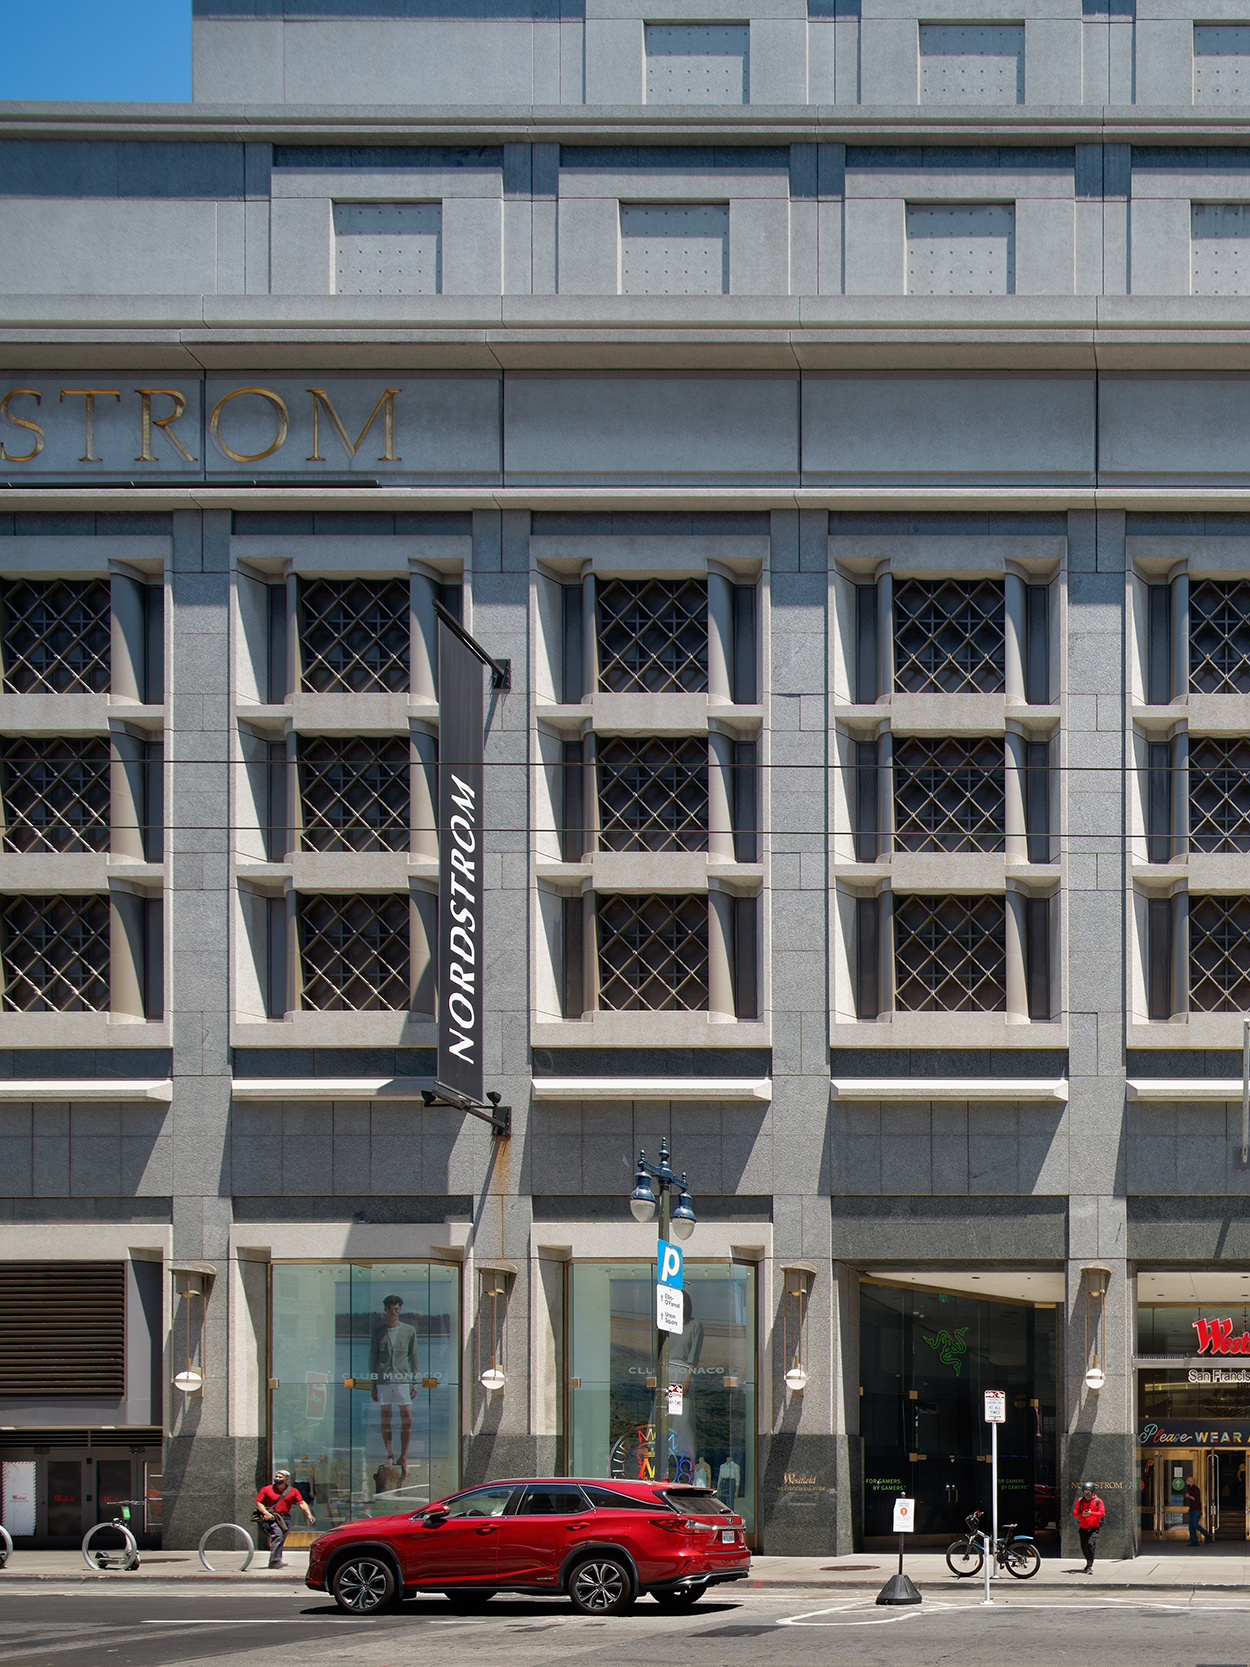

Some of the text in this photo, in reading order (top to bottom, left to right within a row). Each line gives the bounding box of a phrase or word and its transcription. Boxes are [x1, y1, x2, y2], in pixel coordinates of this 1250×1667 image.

[448, 773, 476, 1064] NORDSTROM
[665, 1311, 676, 1320] Union
[665, 1317, 678, 1326] Square
[341, 1372, 443, 1380] CLUB MONACO
[1188, 1369, 1211, 1382] San
[1139, 1423, 1193, 1444] Please
[1195, 1432, 1242, 1443] WEAR
[783, 1472, 817, 1484] Westfield
